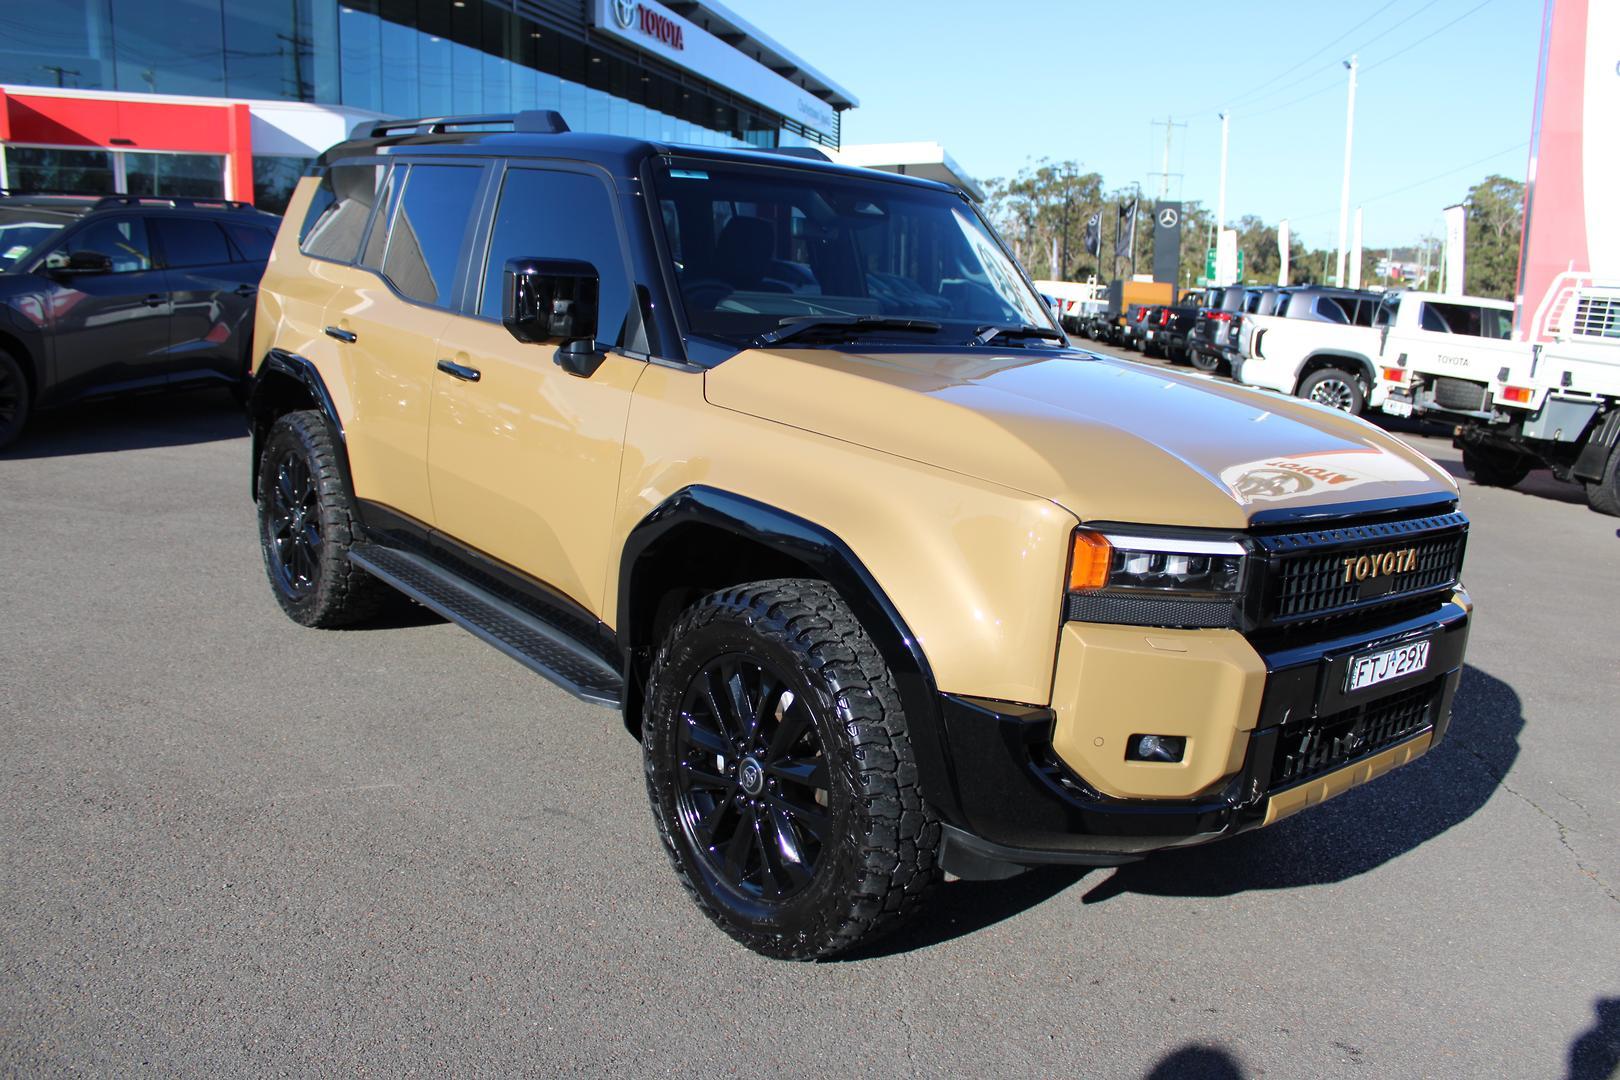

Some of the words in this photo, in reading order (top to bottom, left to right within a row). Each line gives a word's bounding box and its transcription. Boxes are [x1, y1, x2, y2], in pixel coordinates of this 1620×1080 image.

[636, 3, 684, 50] TOYOTA
[1438, 354, 1469, 366] TOYOTA
[1344, 548, 1417, 583] TOYOTA
